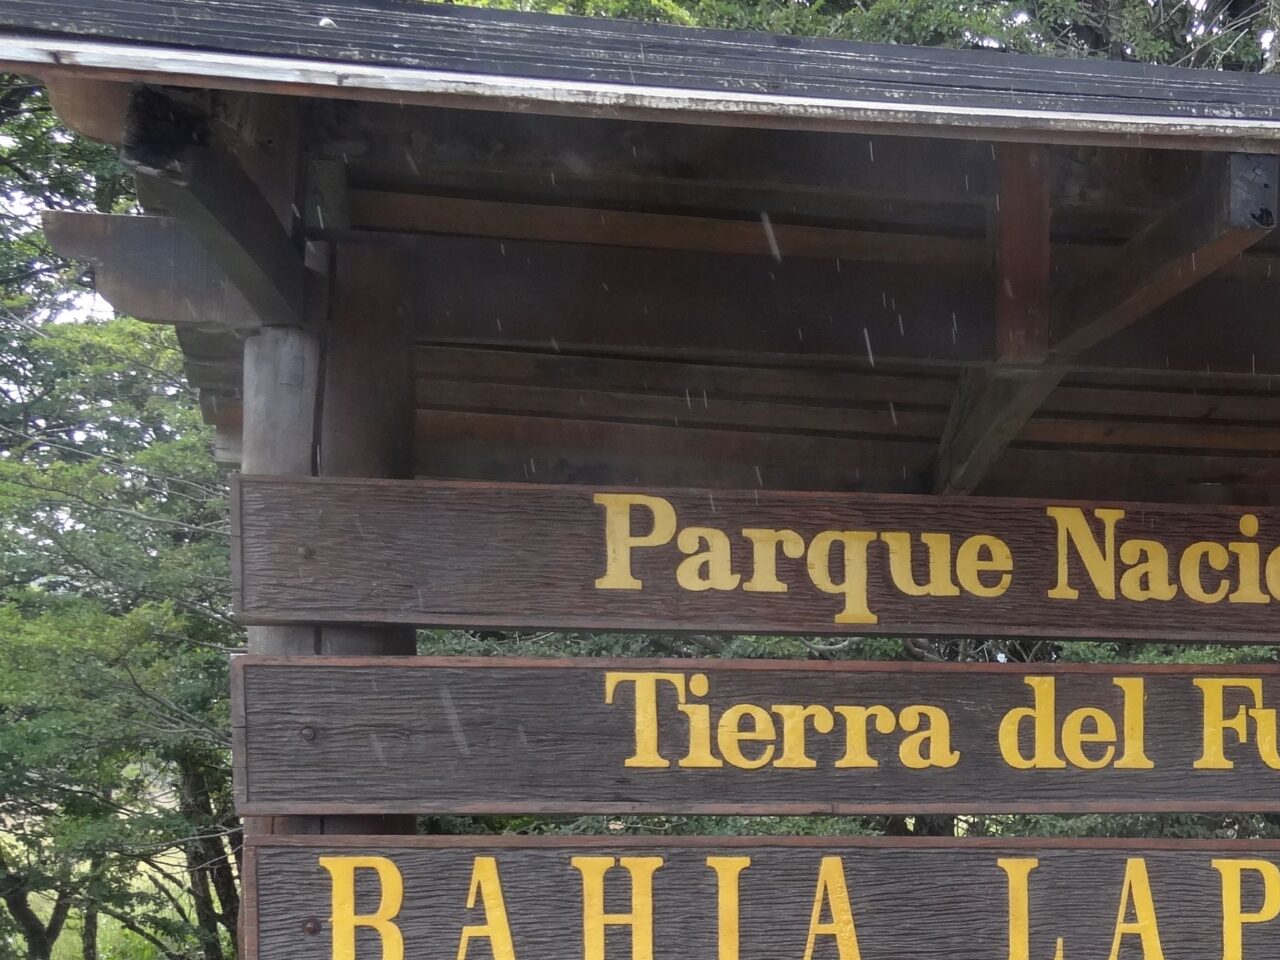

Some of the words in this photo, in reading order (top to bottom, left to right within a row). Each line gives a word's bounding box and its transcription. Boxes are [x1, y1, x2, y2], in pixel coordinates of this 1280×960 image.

[594, 493, 1013, 624] Parque
[604, 671, 960, 769] Tierra
[998, 676, 1153, 769] del
